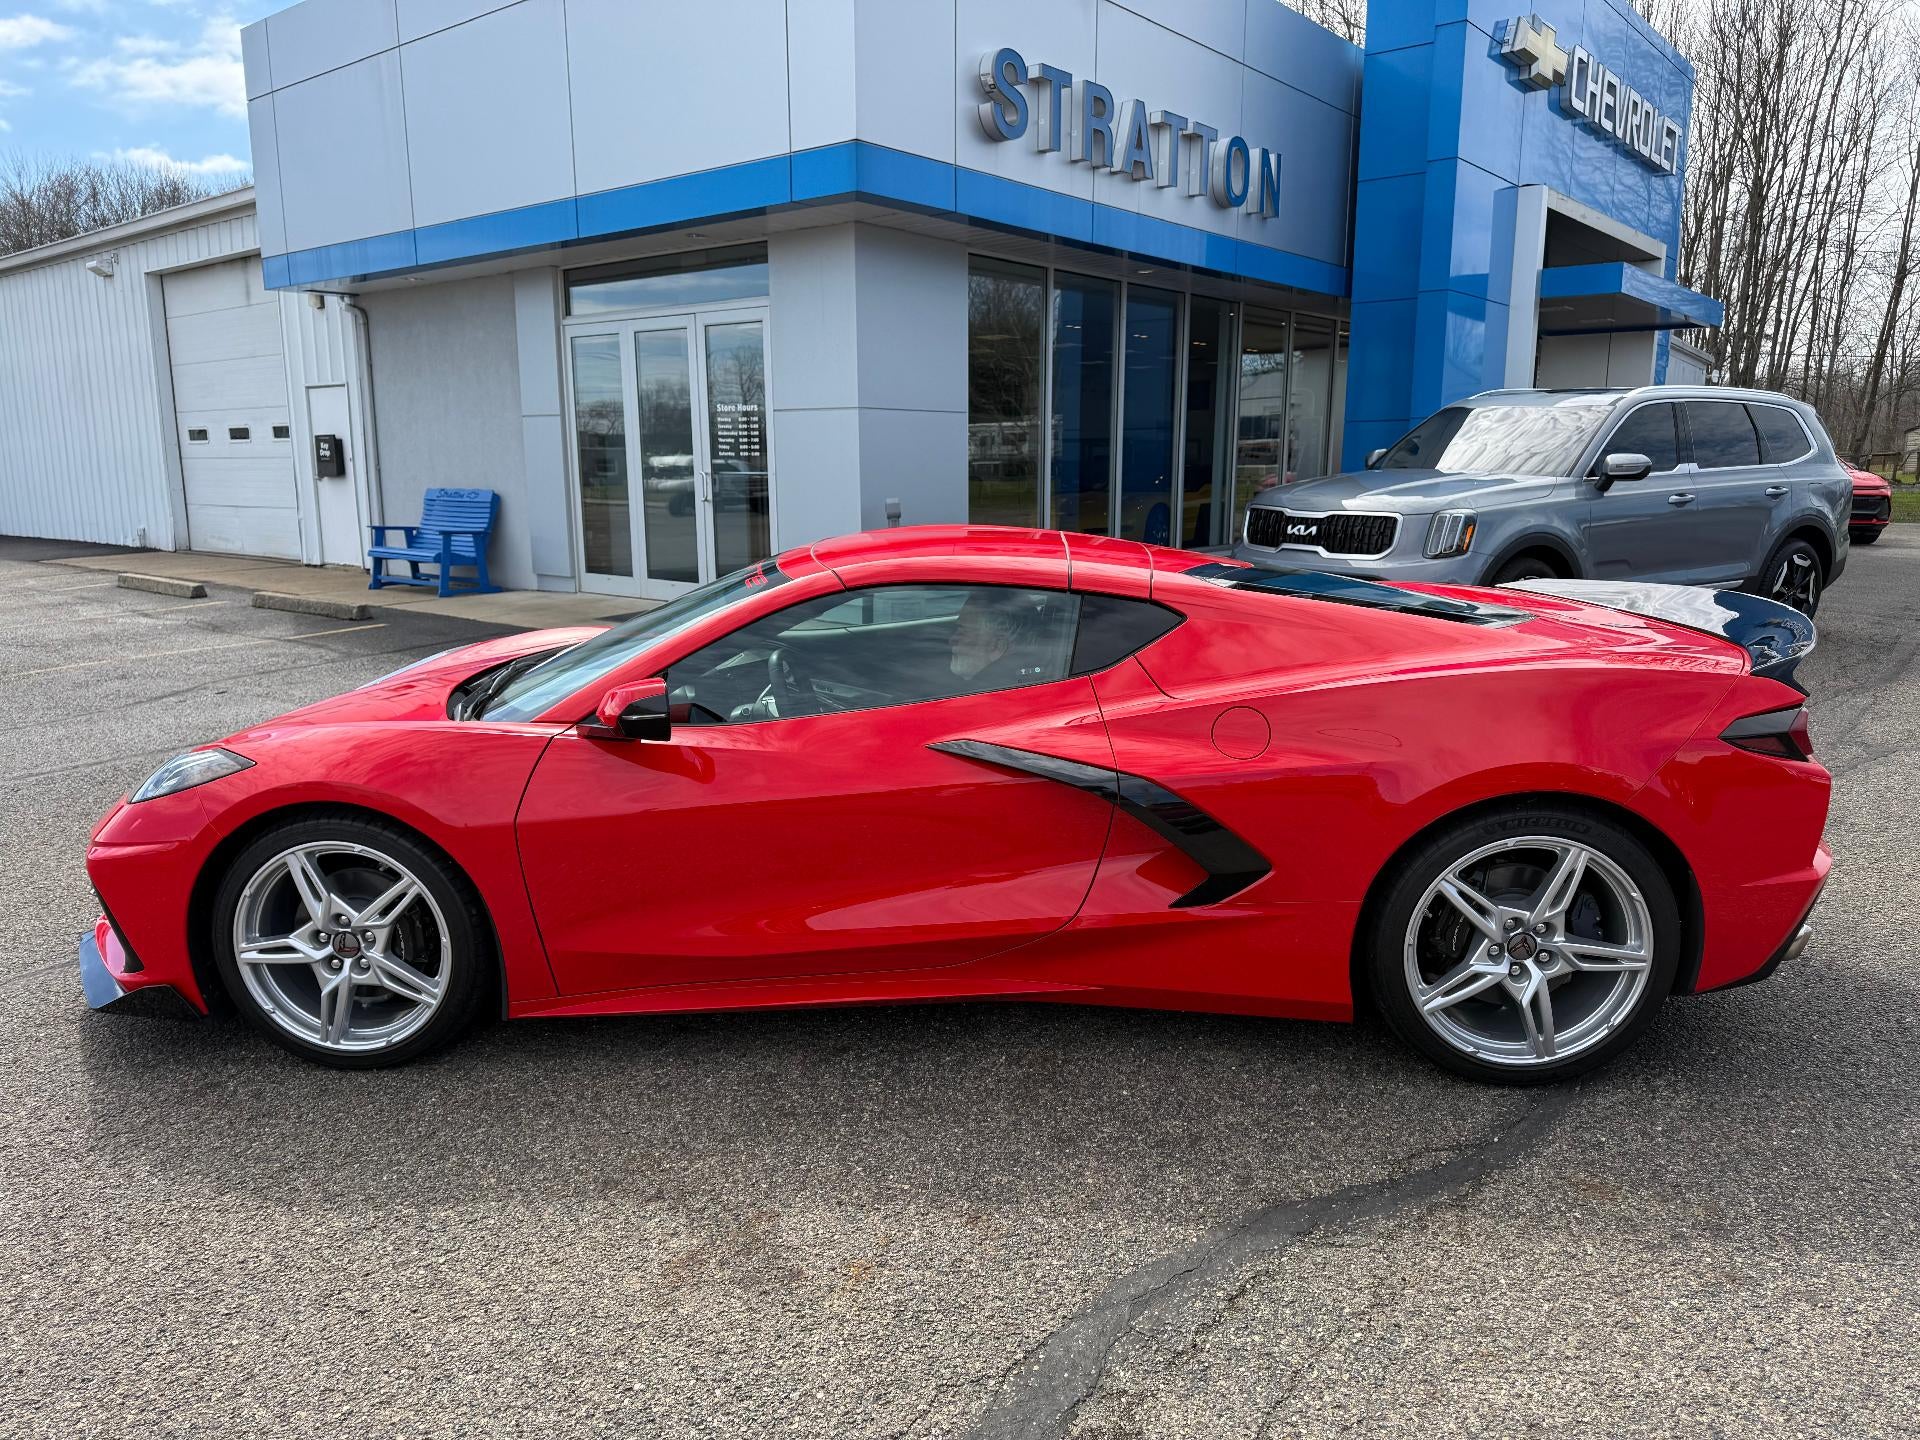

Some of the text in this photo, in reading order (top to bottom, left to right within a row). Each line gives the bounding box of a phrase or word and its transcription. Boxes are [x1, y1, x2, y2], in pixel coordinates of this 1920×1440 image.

[1562, 45, 1683, 176] CHEVROLET
[979, 47, 1282, 219] STRATTON
[716, 403, 759, 412] Store Hours
[1287, 524, 1317, 536] KIA
[1504, 816, 1590, 833] MICHELIN
